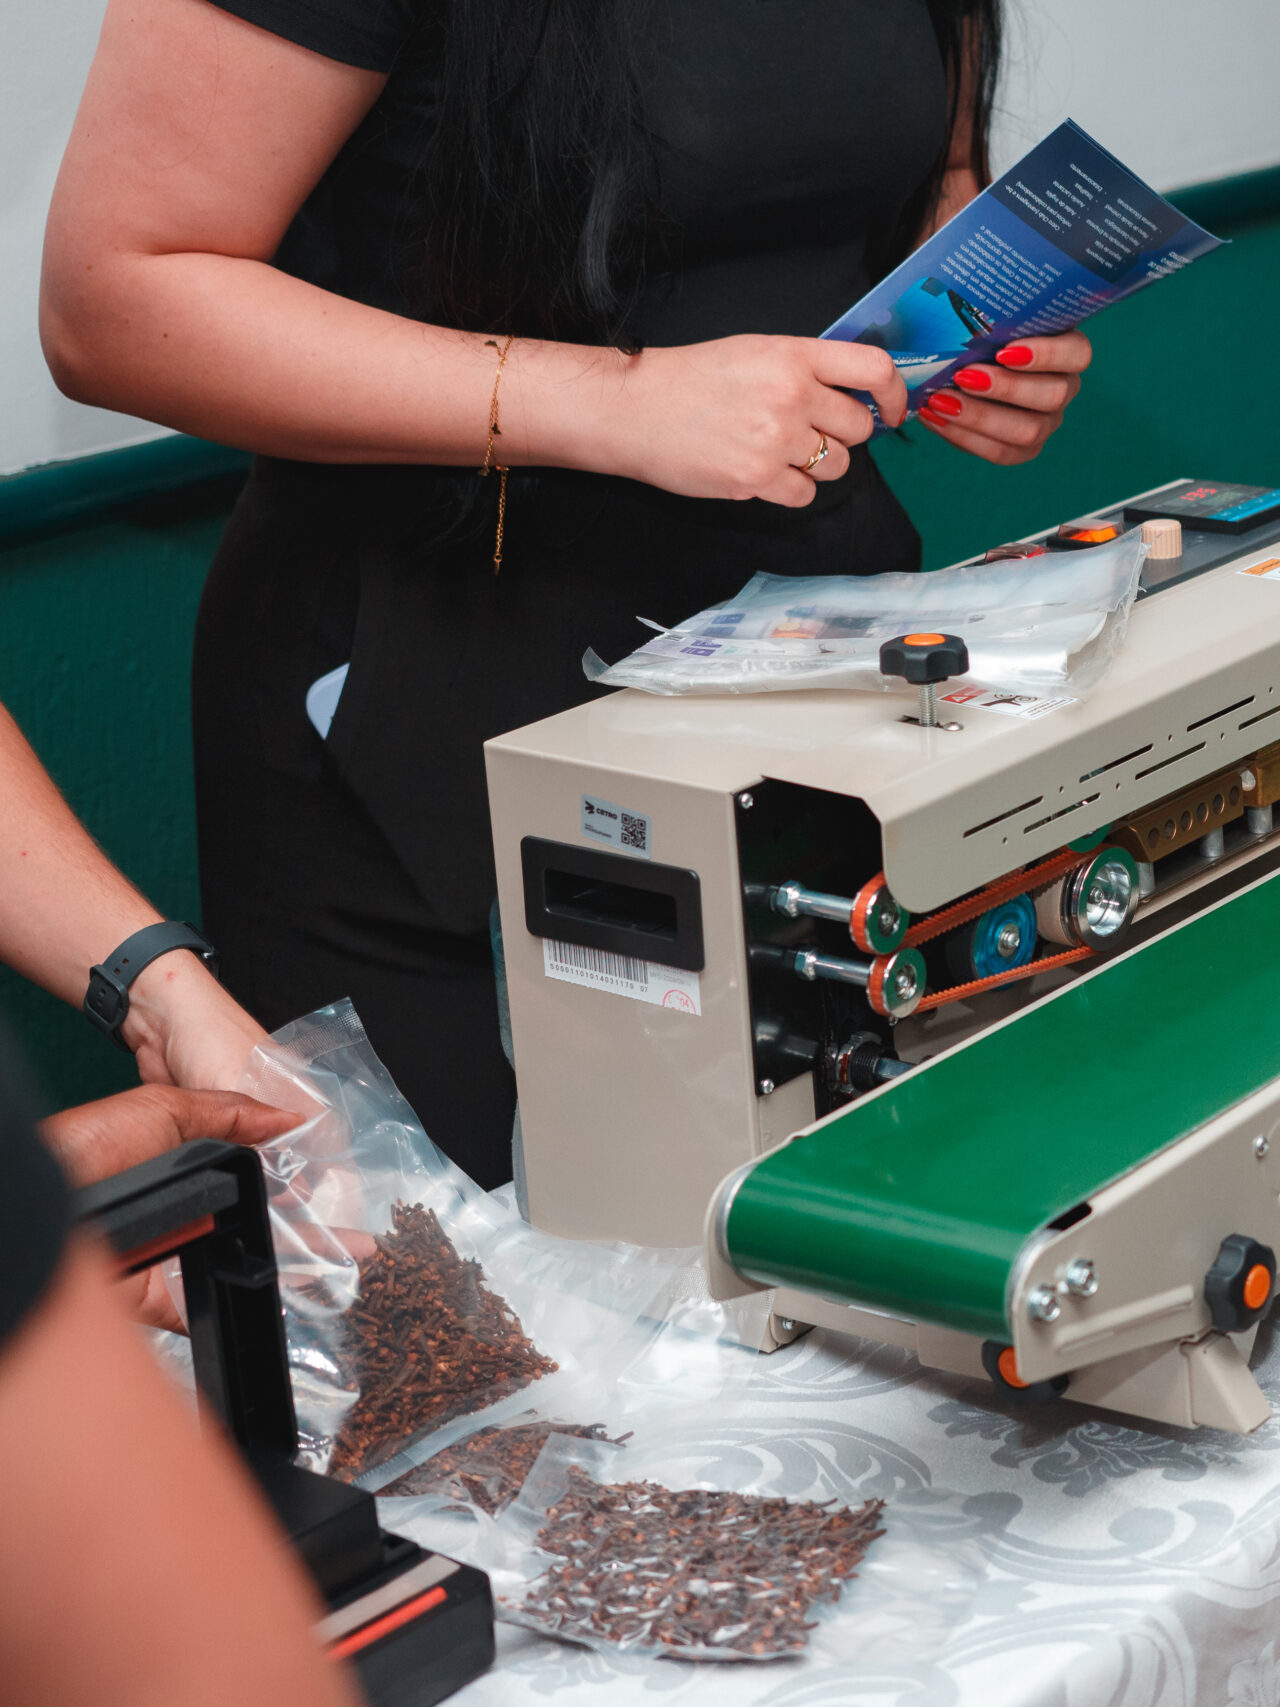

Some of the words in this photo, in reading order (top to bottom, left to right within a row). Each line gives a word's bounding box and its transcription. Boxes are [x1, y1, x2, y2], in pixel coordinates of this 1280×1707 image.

[1067, 163, 1103, 191] Estacionamento
[1002, 184, 1013, 193] be-
[1051, 180, 1071, 197] Lactante
[1072, 183, 1094, 200] TotalPass
[1044, 189, 1060, 202] Inglês
[1069, 195, 1085, 208] Auxílio
[1046, 205, 1057, 215] para
[1063, 205, 1076, 216] Aulas
[1036, 212, 1049, 222] Club
[1055, 213, 1072, 227] nefícios
[1047, 220, 1060, 231] Cetro
[1180, 487, 1217, 502] 135
[596, 807, 618, 820] CETRO
